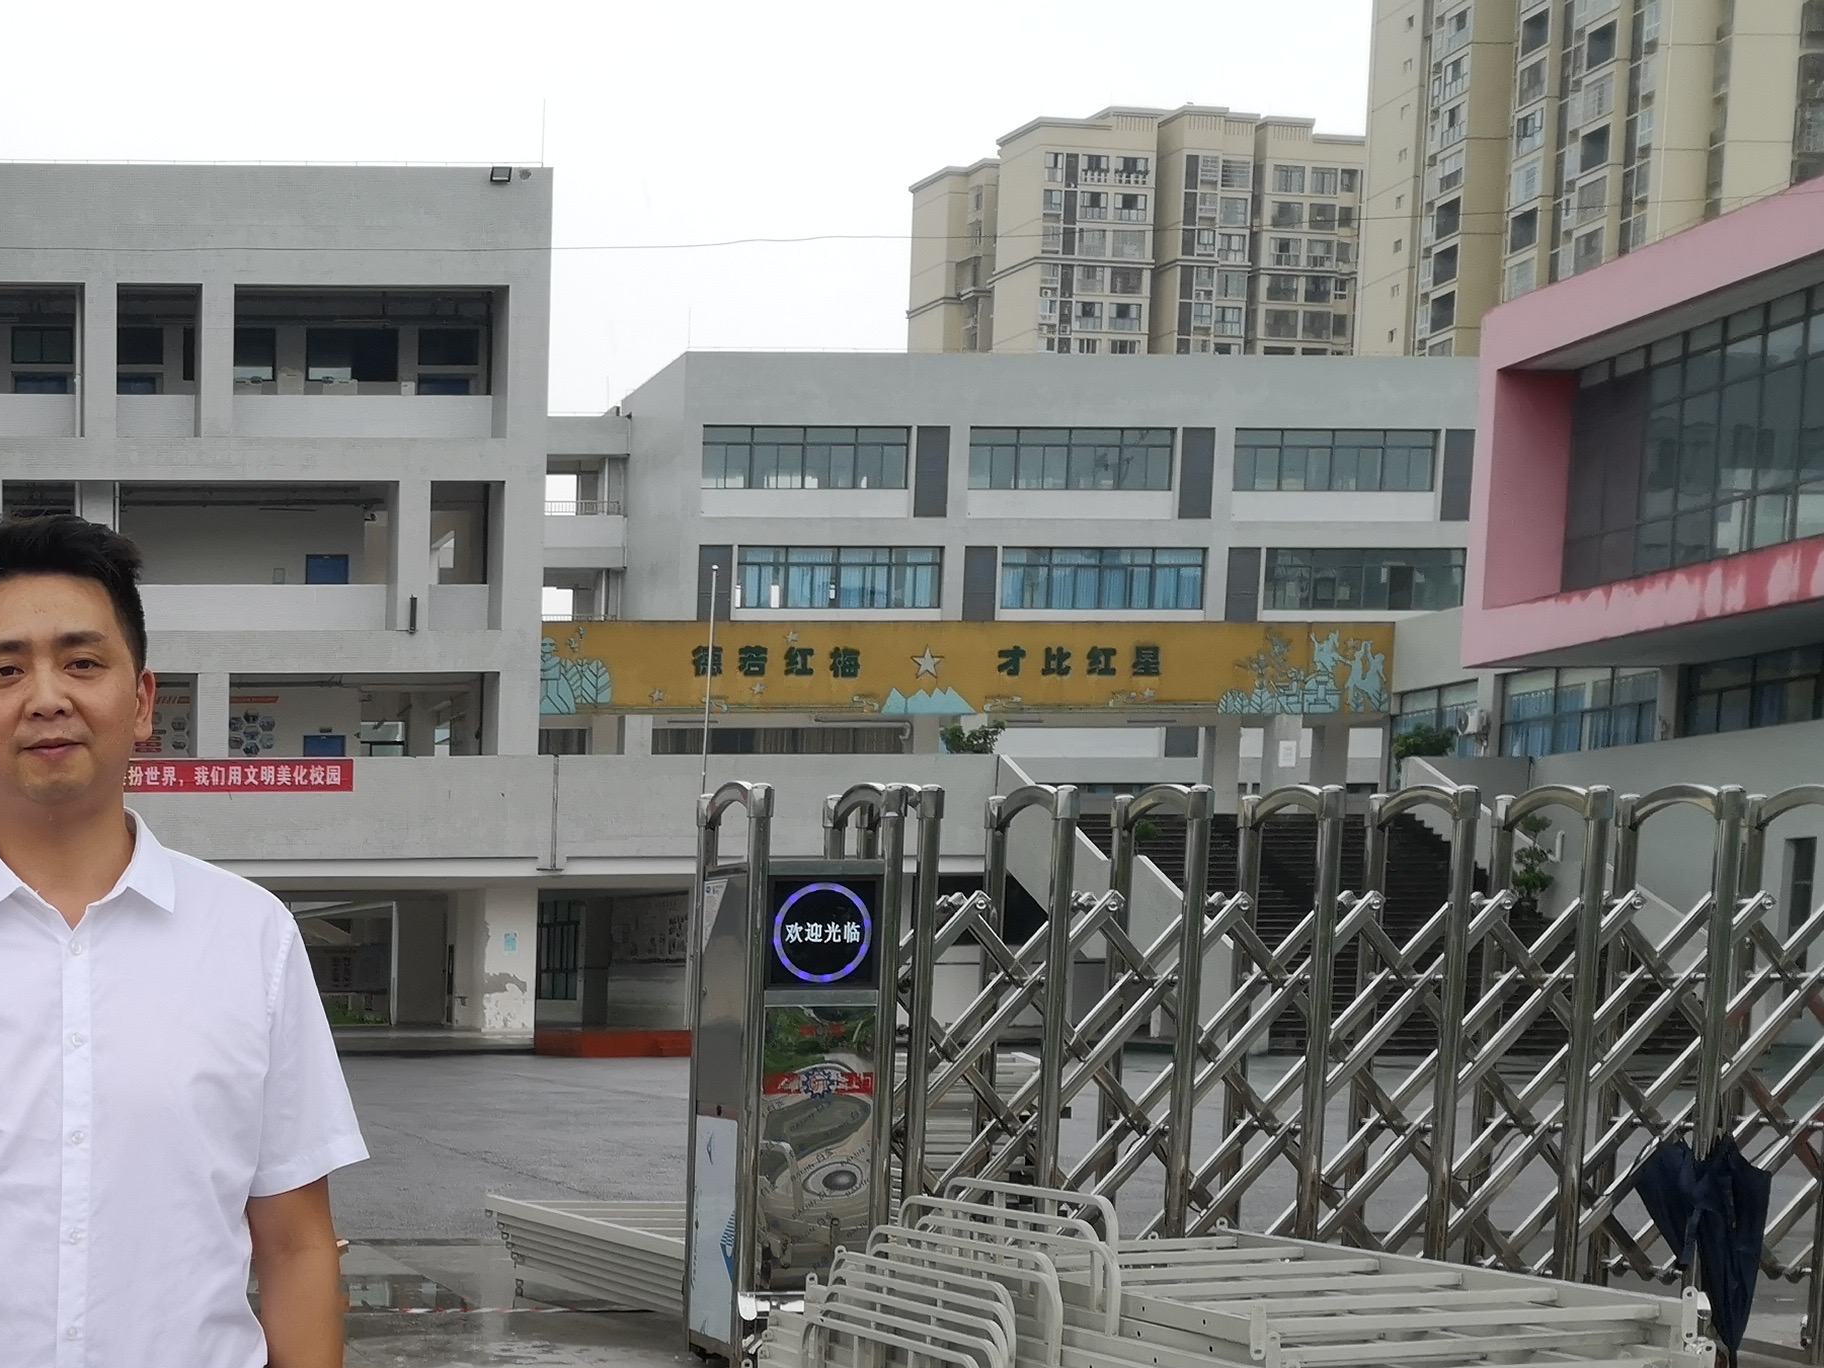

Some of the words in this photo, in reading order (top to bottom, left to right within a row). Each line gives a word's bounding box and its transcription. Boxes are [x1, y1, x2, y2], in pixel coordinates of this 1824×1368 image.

[996, 645, 1163, 679] 才比红星
[123, 765, 342, 788] 扮世界，我们用文明美化校园
[784, 921, 862, 946] 欢迎光临
